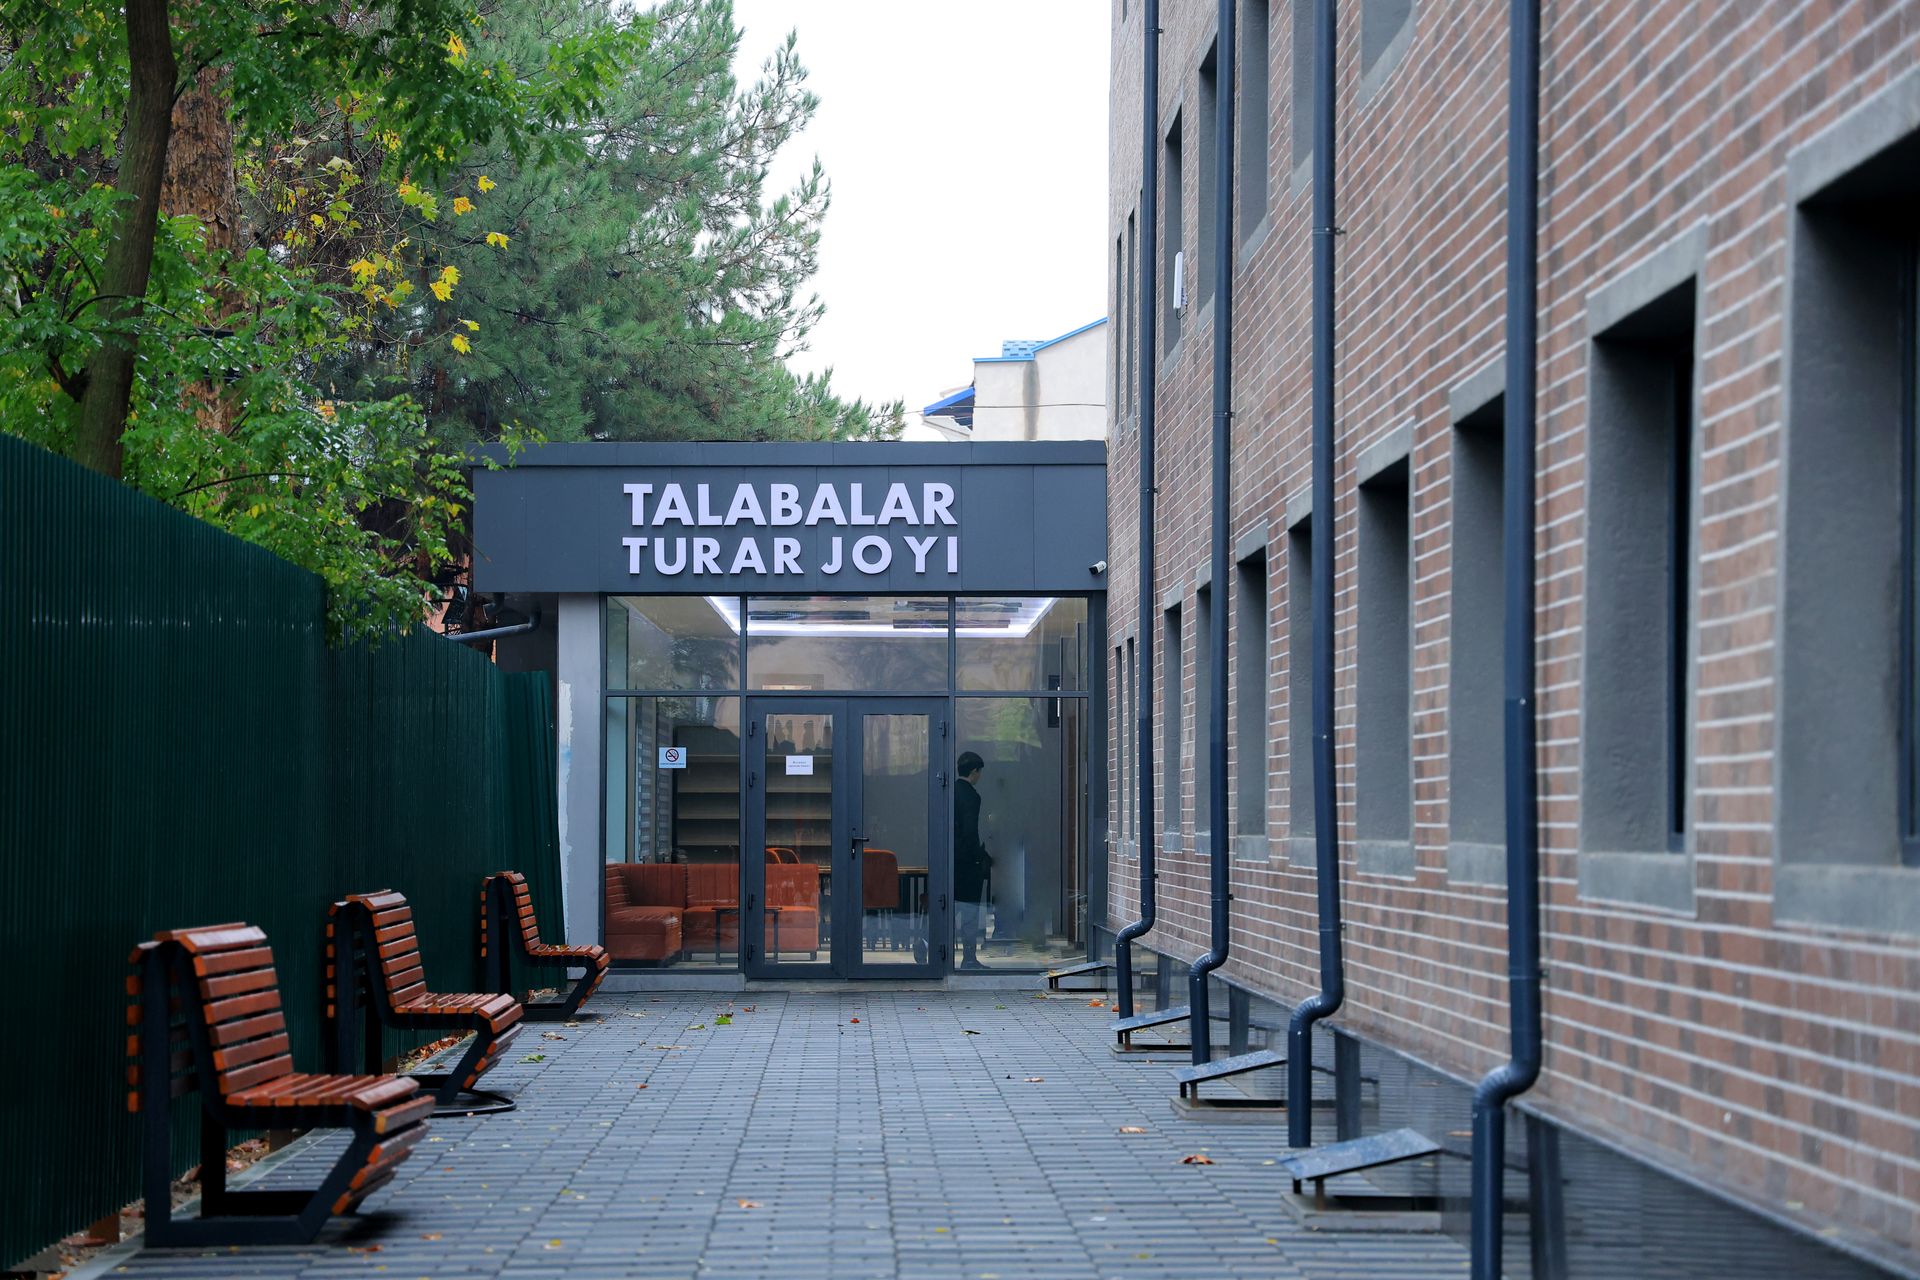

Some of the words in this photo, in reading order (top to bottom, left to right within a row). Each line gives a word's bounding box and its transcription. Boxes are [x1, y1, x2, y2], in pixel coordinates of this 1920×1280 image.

[623, 483, 957, 525] TALABALAR
[622, 537, 804, 574] TURAR
[821, 535, 957, 574] JOYI
